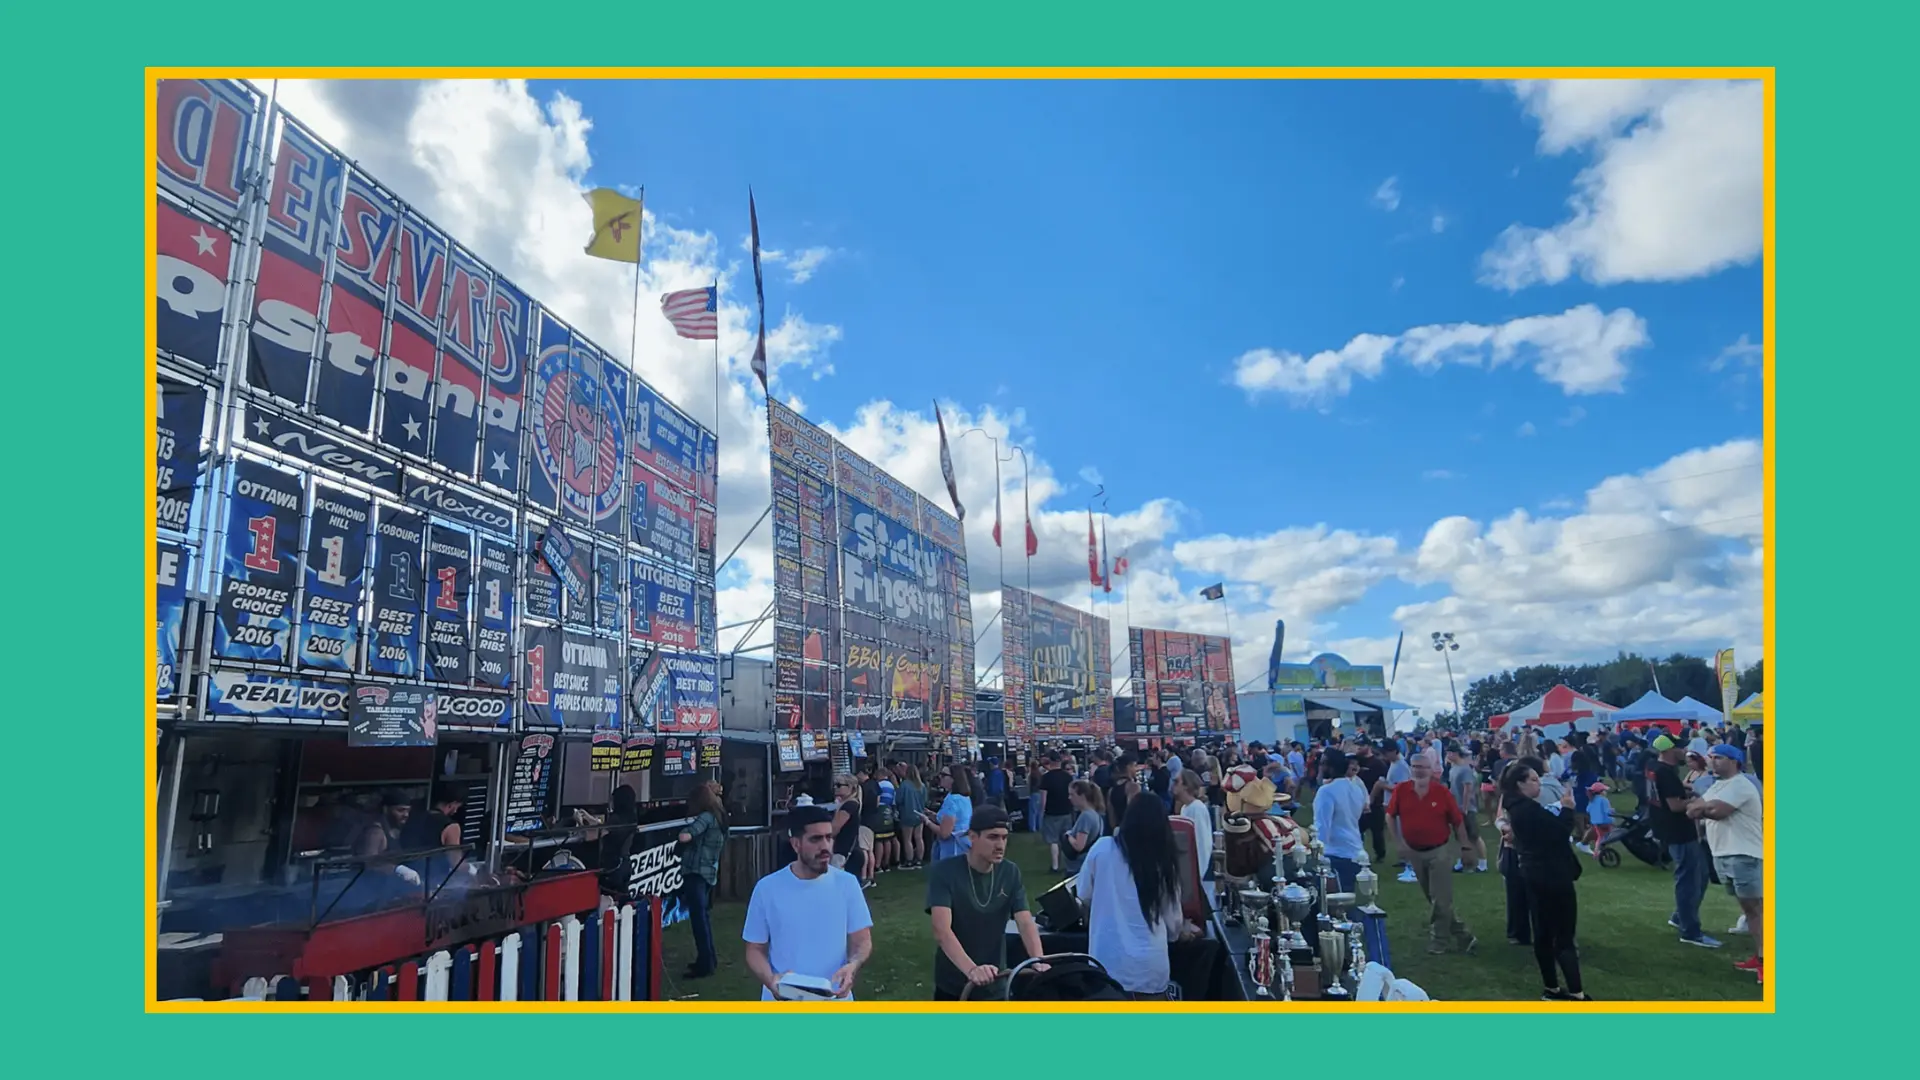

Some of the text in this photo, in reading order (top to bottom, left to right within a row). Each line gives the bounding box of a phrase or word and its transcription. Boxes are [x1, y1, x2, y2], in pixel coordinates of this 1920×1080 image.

[637, 401, 651, 451] 1
[272, 432, 394, 480] New
[238, 480, 298, 511] OTTAWA
[157, 496, 190, 524] 2015
[315, 499, 366, 523] RICHMOND
[410, 485, 510, 528] Mexico
[632, 481, 647, 530] 1
[329, 515, 350, 531] HILL
[378, 523, 420, 544] COBOURG
[245, 515, 281, 574] 1
[431, 541, 469, 560] MISSISSAUGA
[318, 536, 347, 588] 1
[487, 548, 506, 561] TROIS
[481, 558, 511, 574] RIVIERES
[389, 552, 415, 600] 1
[634, 562, 692, 595] KITCHENER
[228, 581, 289, 603] PEOPLES
[436, 566, 459, 613] 1
[232, 598, 283, 617] CHOICE
[309, 596, 353, 614] BEST
[484, 579, 503, 621] 1
[633, 583, 650, 633] 1
[659, 592, 685, 607] BEST
[308, 610, 351, 628] RIBS
[378, 608, 415, 625] BEST
[656, 602, 686, 618] SAUCE
[234, 626, 274, 645] 2016
[378, 621, 413, 636] RIBS
[434, 621, 461, 633] BEST
[479, 628, 508, 642] BEST
[308, 637, 346, 655] 2016
[430, 632, 464, 646] SAUCE
[479, 640, 506, 652] RIBS
[662, 631, 683, 643] 2018
[378, 646, 406, 661] 2016
[434, 655, 459, 669] 2016
[562, 641, 607, 669] OTTAWA
[846, 645, 881, 671] BBQ
[480, 661, 502, 675] 2016
[527, 645, 549, 705] 1
[553, 672, 569, 690] BEST
[569, 674, 589, 691] SAUCE
[675, 677, 714, 692] BEST RIBS
[223, 683, 298, 706] REAL
[553, 694, 581, 712] PEOPLES
[581, 696, 603, 712] CHOICE
[451, 698, 505, 717] GOOD
[629, 845, 664, 880] REAL
